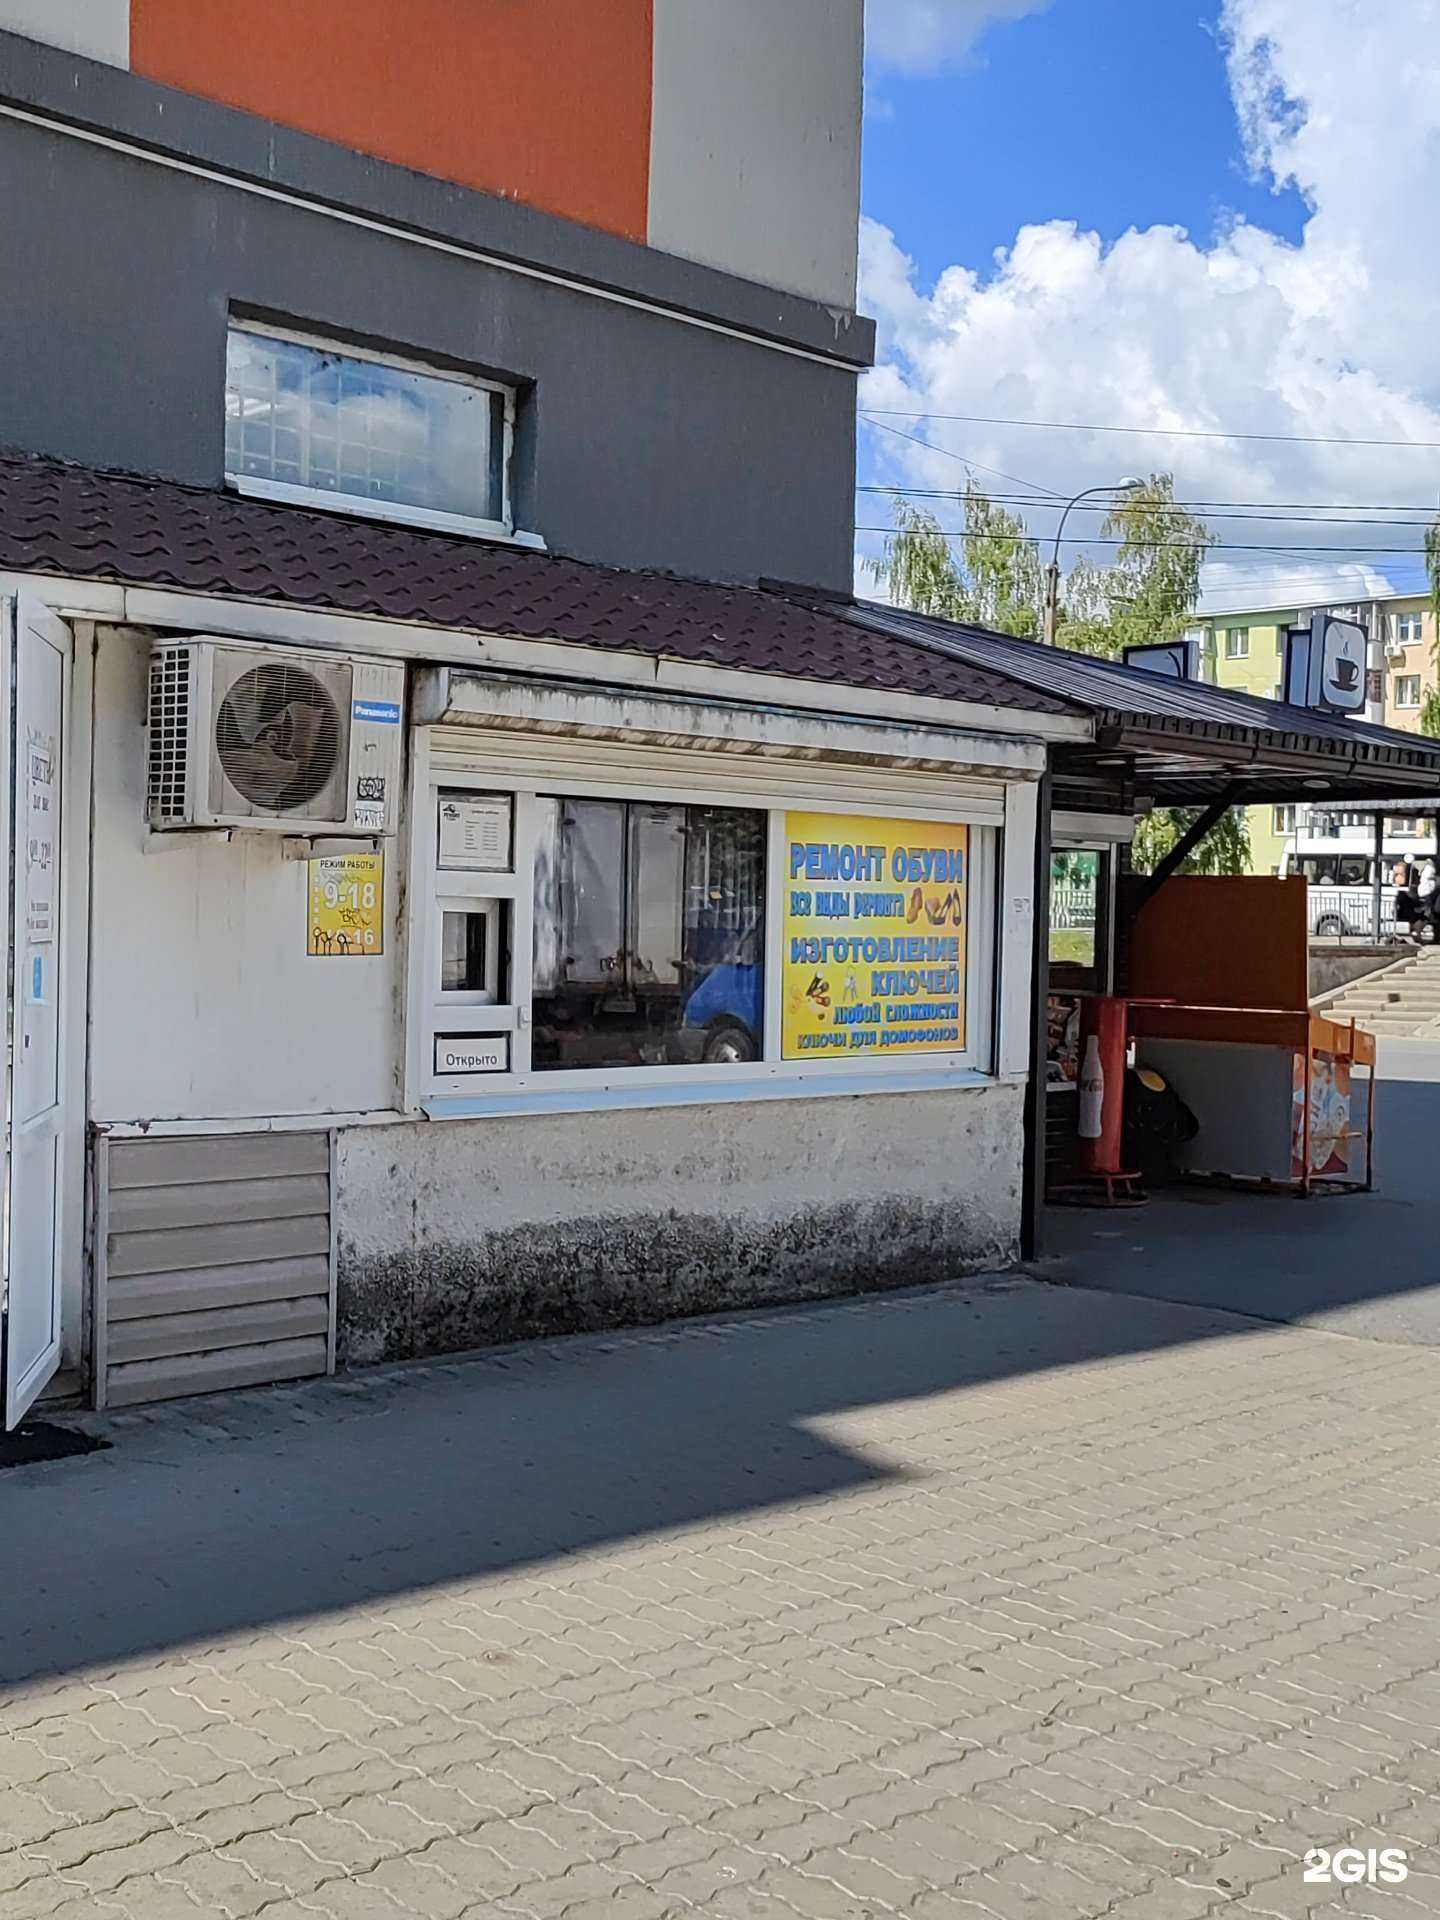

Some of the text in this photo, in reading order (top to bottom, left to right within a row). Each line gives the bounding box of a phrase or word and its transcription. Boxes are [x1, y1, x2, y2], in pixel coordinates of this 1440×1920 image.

[320, 859, 375, 870] РЕЖИМ РАБОТЫ
[790, 842, 963, 884] РЕМОНТ ОБУВИ
[324, 881, 376, 909] 9-18
[790, 936, 960, 964] ИЗГОТОВЛЕНИЕ
[870, 963, 960, 997] КЛЮЧЕЙ
[446, 1053, 498, 1068] Открыто
